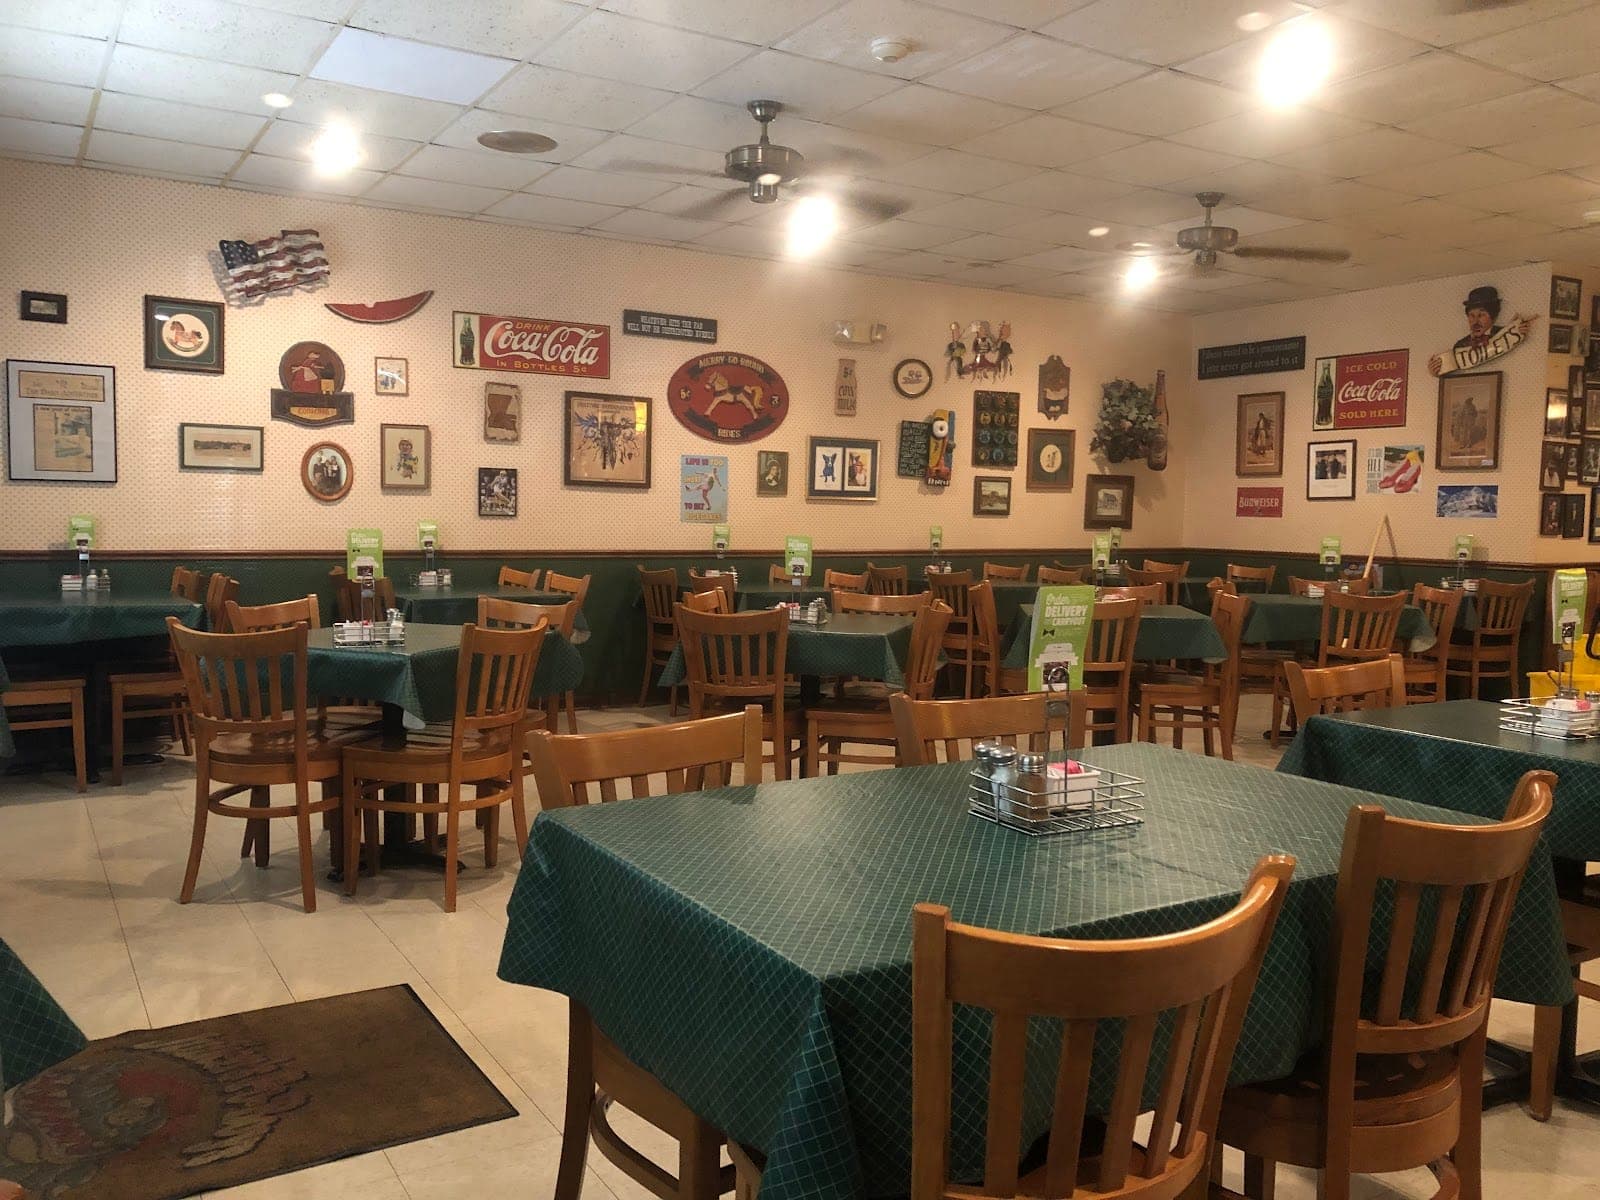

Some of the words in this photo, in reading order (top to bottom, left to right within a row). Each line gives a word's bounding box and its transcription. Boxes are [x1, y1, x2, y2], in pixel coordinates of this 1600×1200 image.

[515, 322, 551, 332] DRINK
[484, 320, 604, 366] Coca-Cola
[1459, 325, 1521, 367] TOILETS
[513, 360, 566, 373] BOTTLES
[1345, 364, 1364, 373] ICE
[1366, 361, 1397, 371] COLD
[1338, 377, 1403, 404] Coca-Cola
[1339, 410, 1367, 420] SOLD
[1369, 408, 1399, 418] HERE
[717, 428, 741, 438] RIDES
[1239, 496, 1280, 508] BUDWEISER
[1045, 605, 1089, 618] DELIVERY
